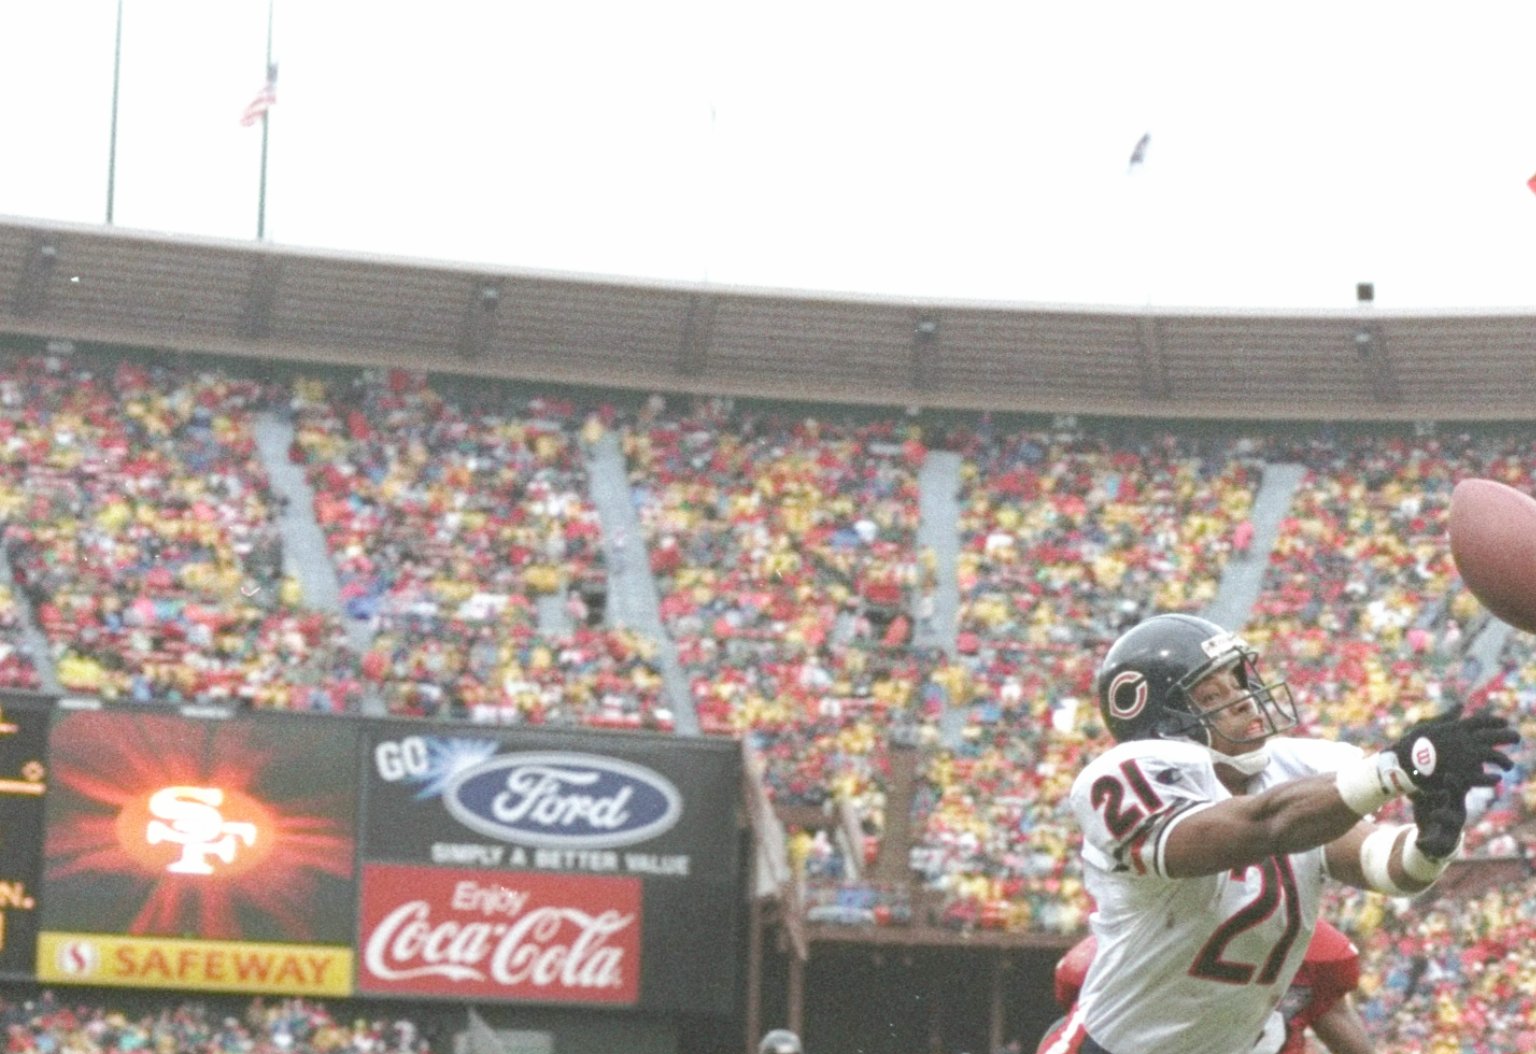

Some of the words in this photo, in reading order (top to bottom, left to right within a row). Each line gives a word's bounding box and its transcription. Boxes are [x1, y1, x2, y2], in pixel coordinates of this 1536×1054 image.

[375, 735, 429, 783] GO
[145, 785, 258, 875] SF
[491, 764, 634, 830] Ford
[1091, 758, 1164, 840] 21
[431, 842, 505, 866] SIMPLY
[510, 847, 528, 867] A
[535, 849, 619, 872] BETTER
[625, 853, 691, 876] VALUE
[452, 880, 531, 915] Enjoy
[1187, 853, 1302, 986] 21
[115, 943, 331, 987] SAFEWAY
[363, 900, 636, 989] Coca-Cola
